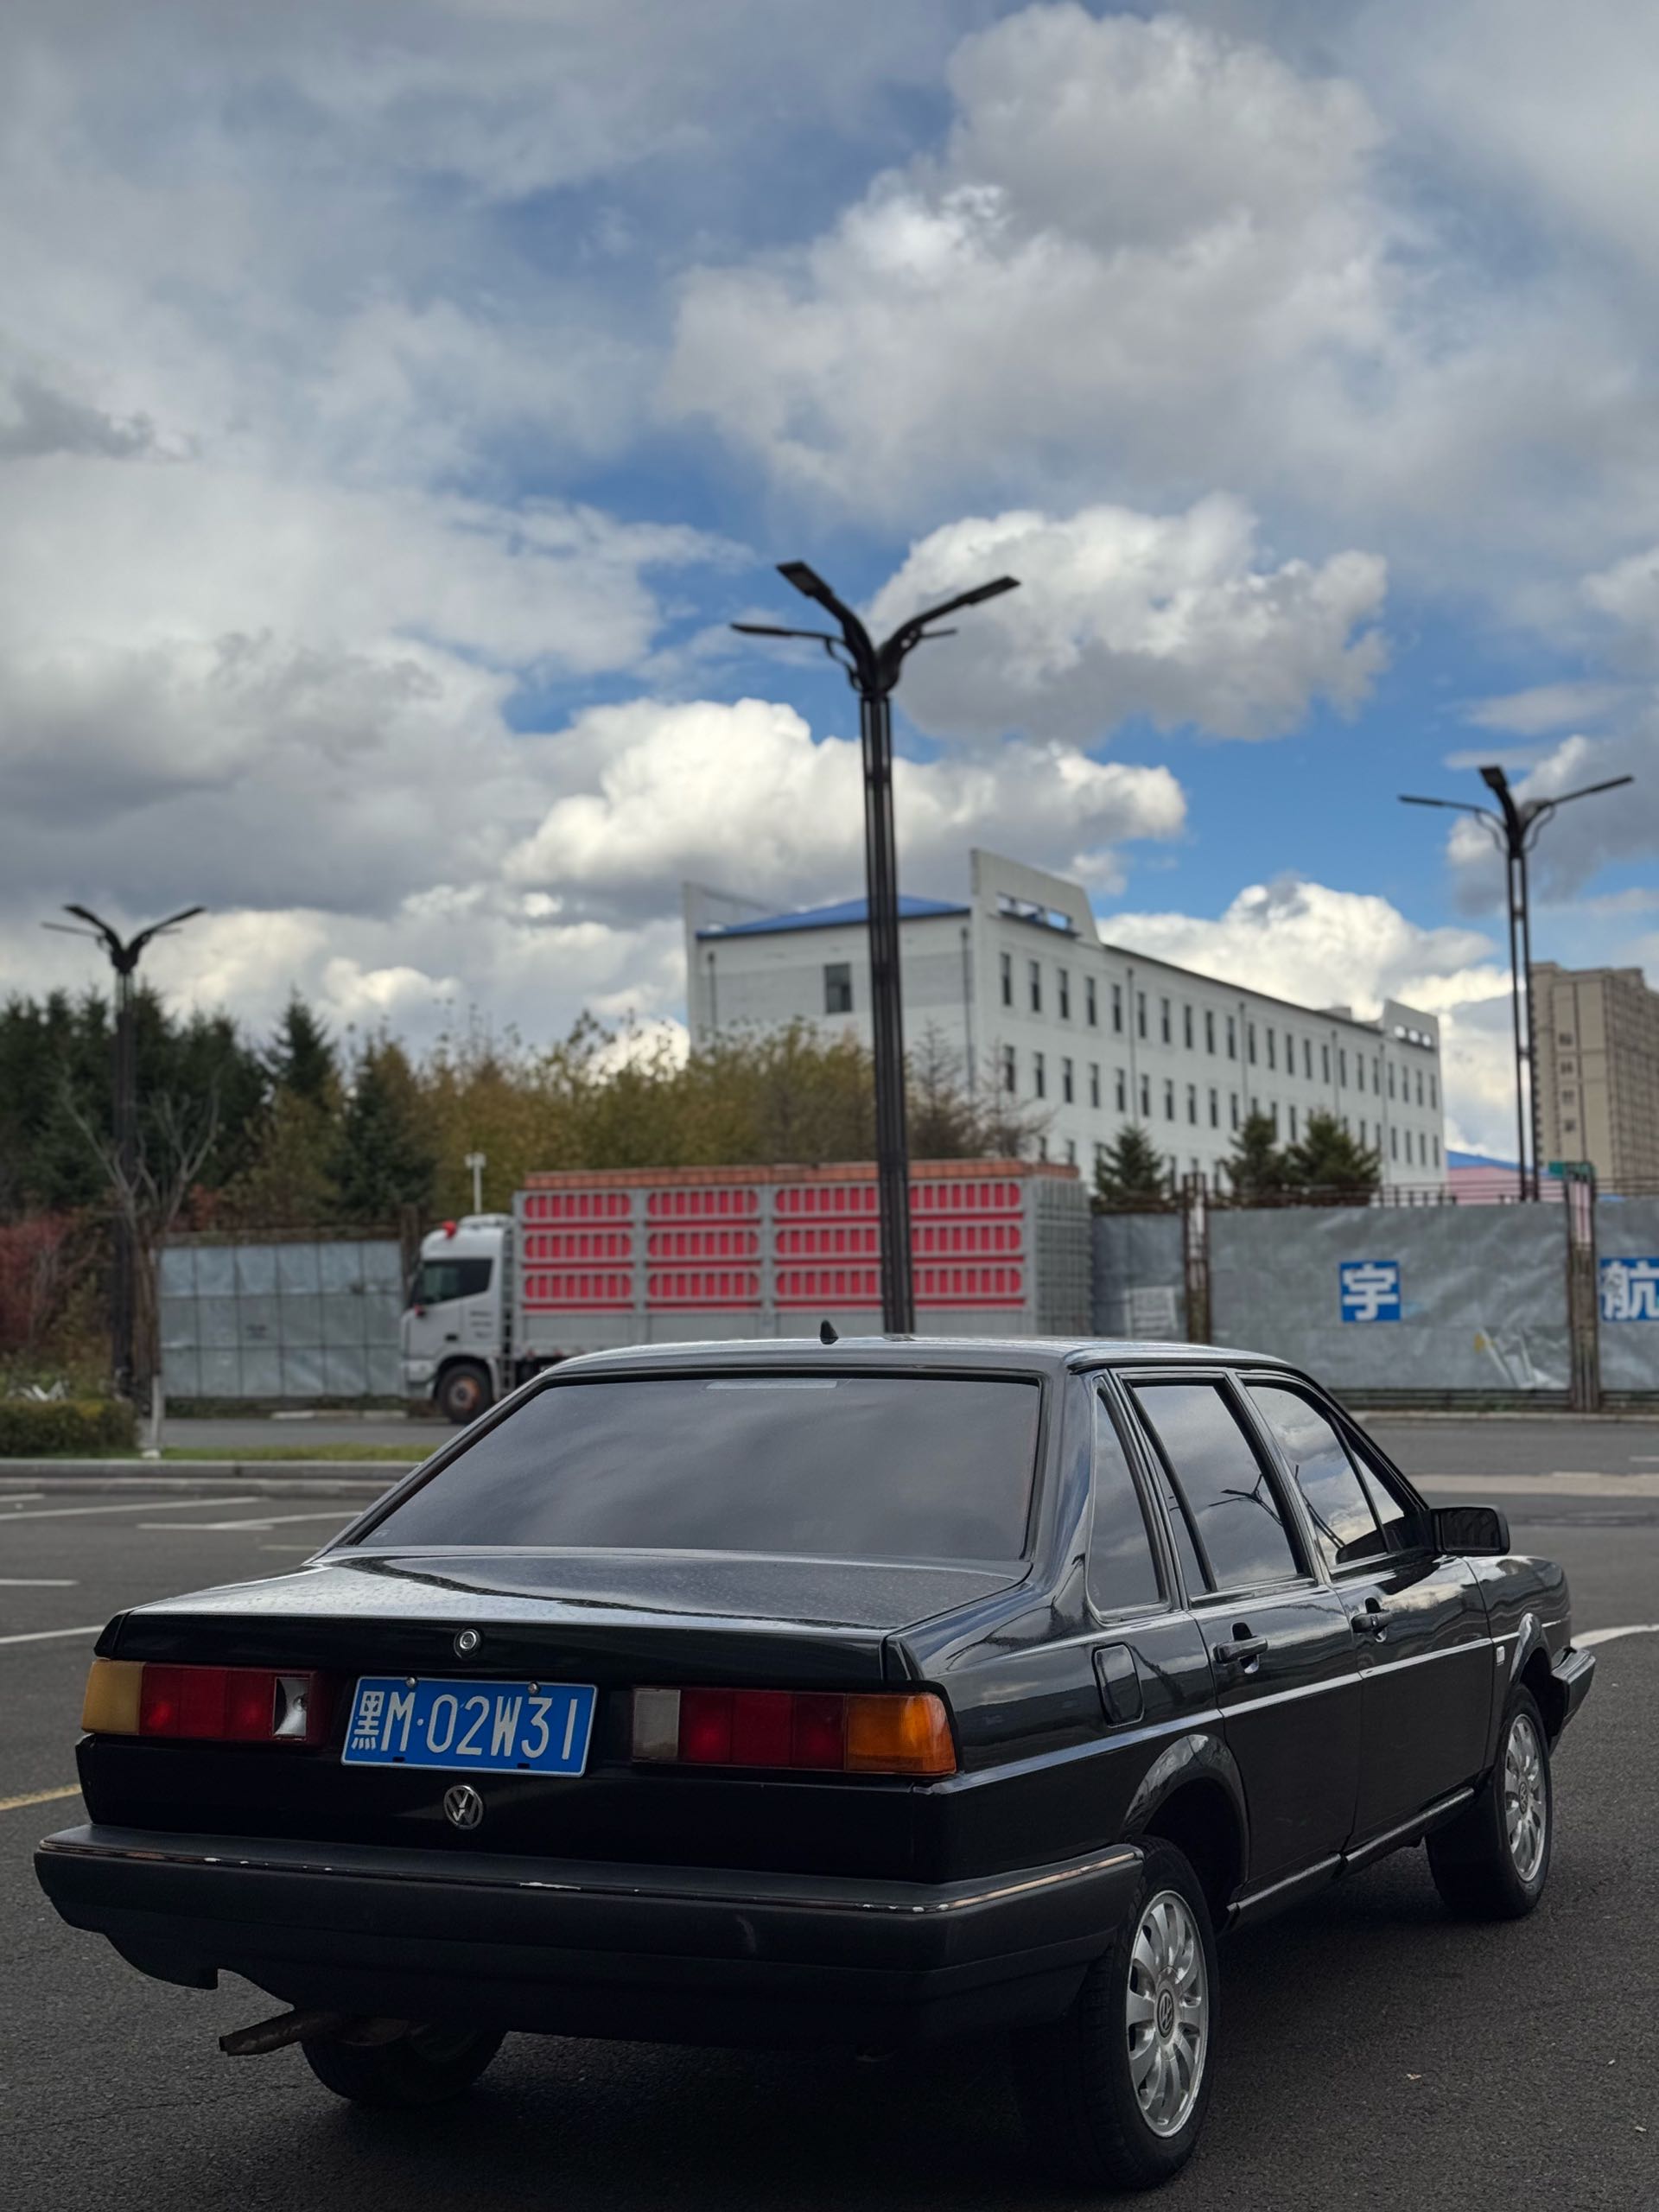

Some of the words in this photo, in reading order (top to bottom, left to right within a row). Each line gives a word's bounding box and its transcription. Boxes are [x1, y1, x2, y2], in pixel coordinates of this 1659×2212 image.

[1342, 1262, 1398, 1320] 宇
[1599, 1259, 1659, 1319] 航
[351, 1689, 579, 1761] 黑M·02W31
